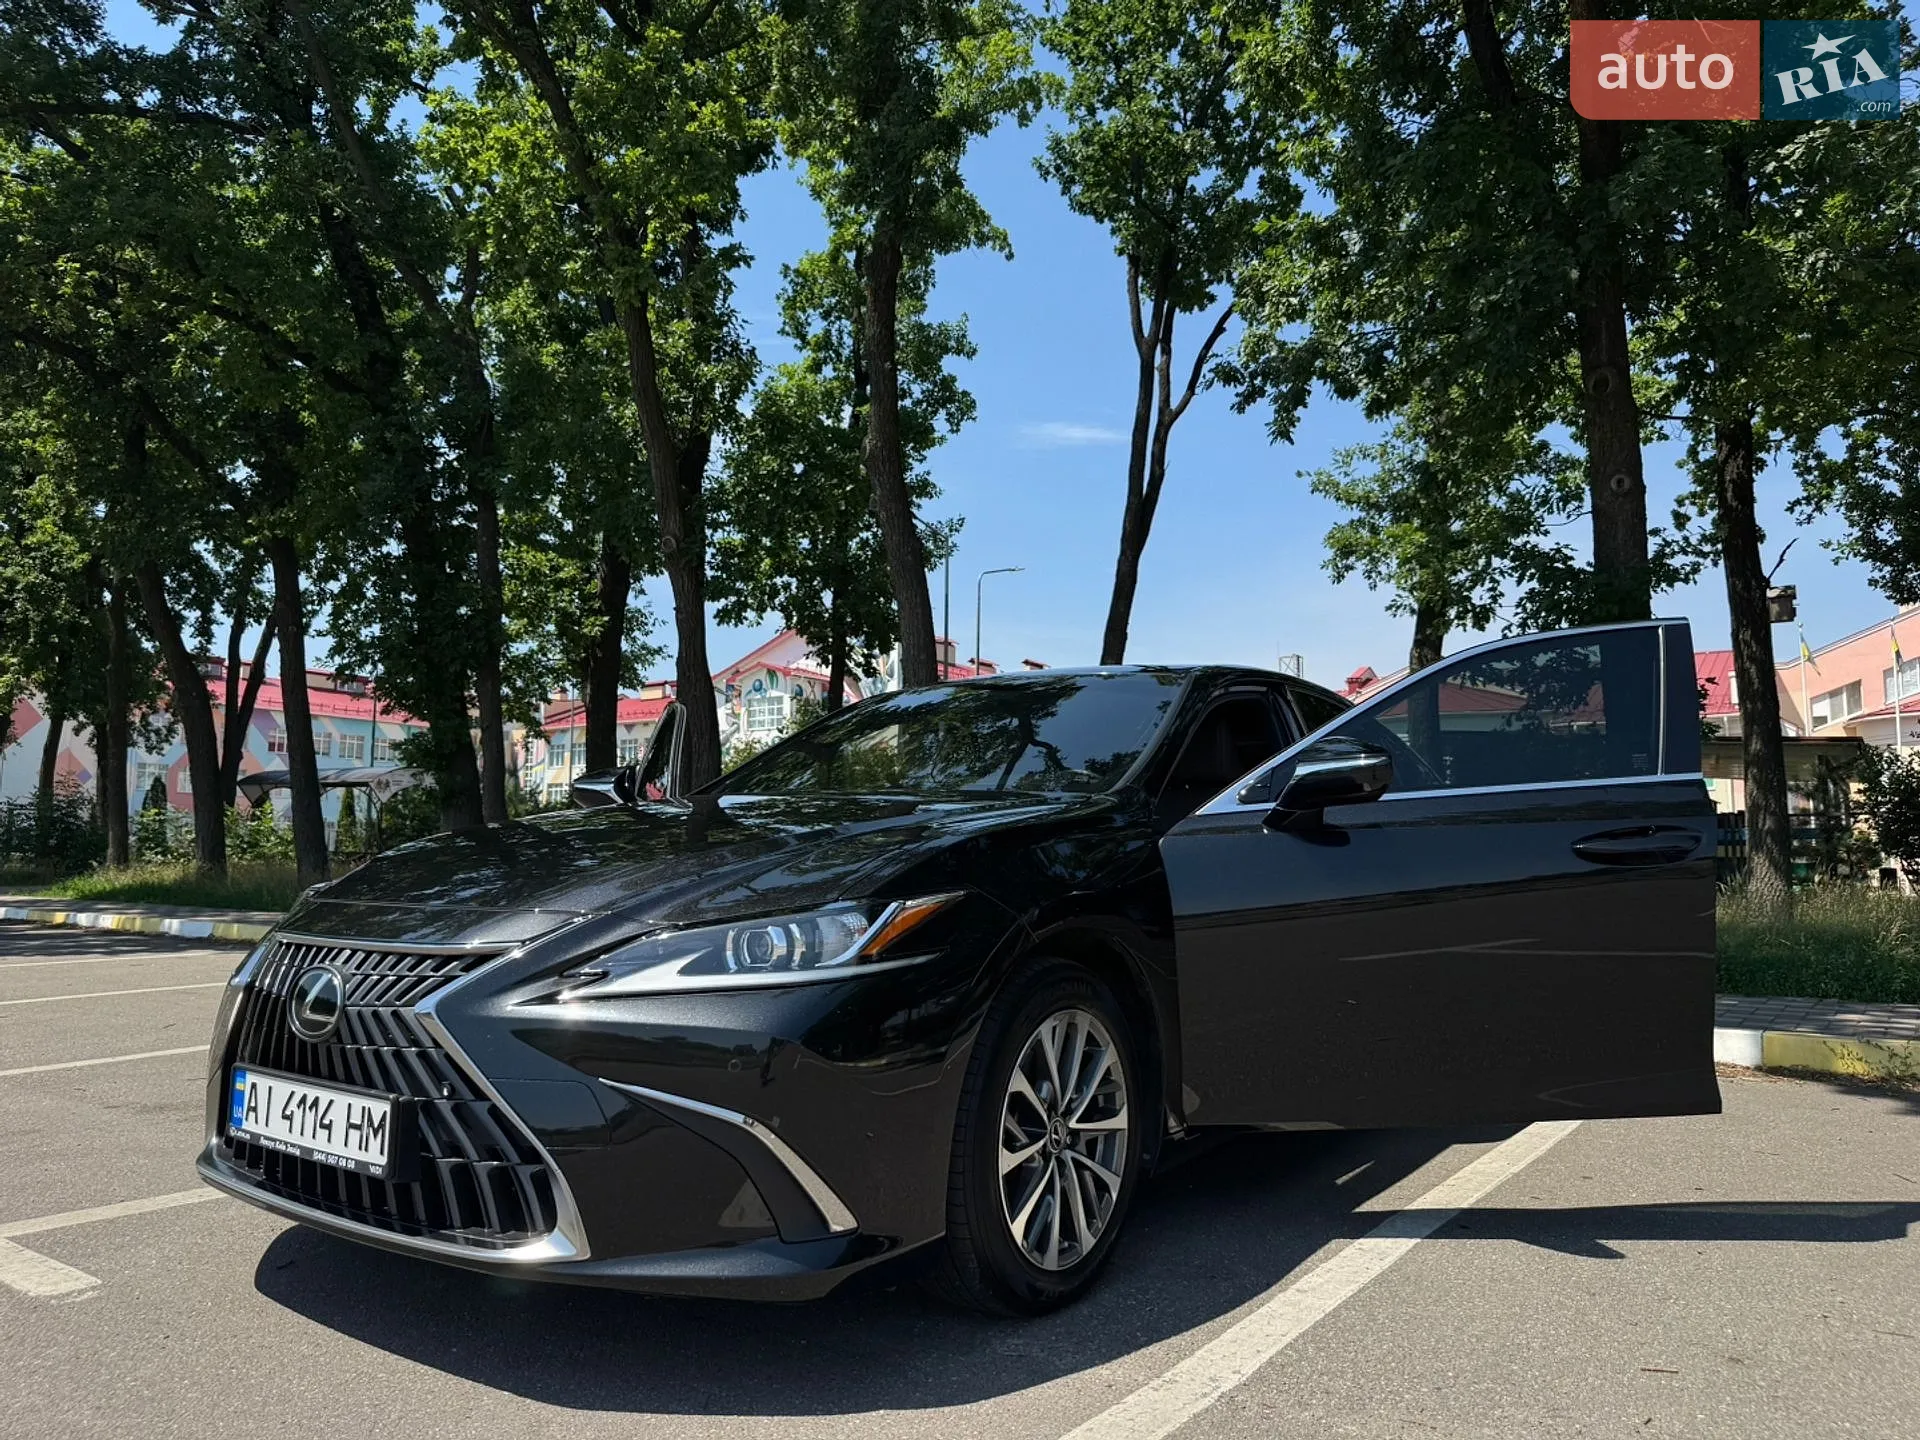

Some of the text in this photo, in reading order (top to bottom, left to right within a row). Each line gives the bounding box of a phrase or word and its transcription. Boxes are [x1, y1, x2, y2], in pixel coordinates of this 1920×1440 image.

[233, 1106, 244, 1118] UA
[245, 1081, 388, 1157] AI 4114 HM
